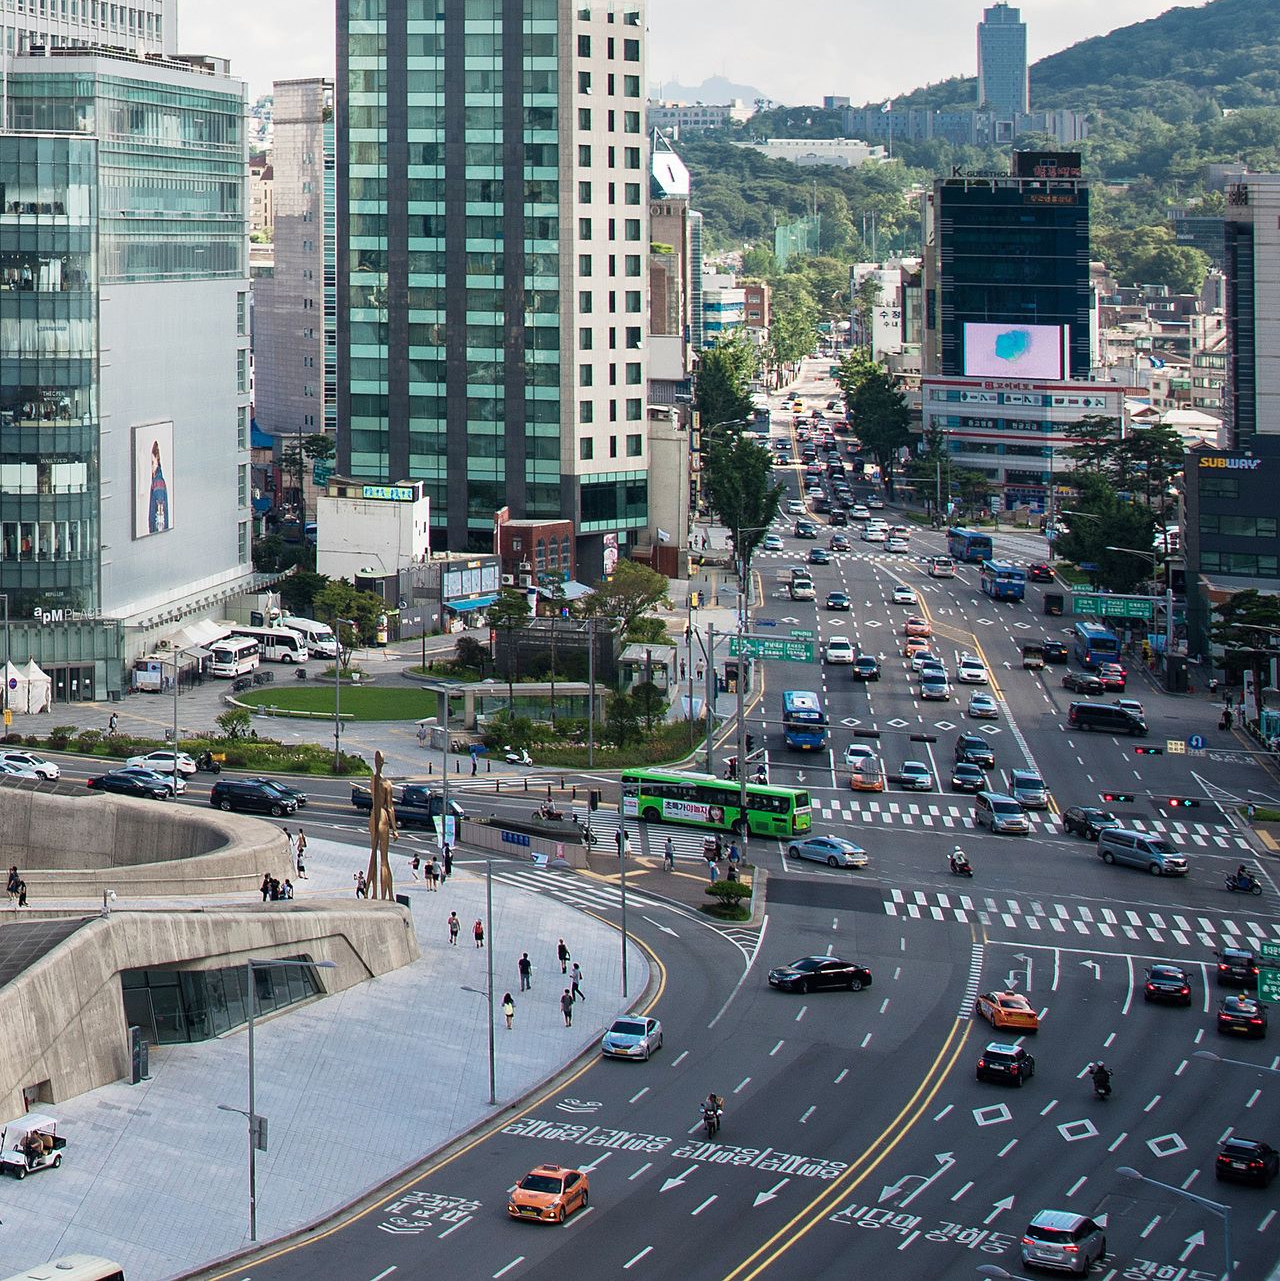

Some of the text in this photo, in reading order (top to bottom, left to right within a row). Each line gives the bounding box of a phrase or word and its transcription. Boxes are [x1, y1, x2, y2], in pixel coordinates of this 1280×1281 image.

[1199, 457, 1261, 469] SUBWAY
[33, 606, 63, 625] apM
[384, 1201, 470, 1222] 자전거
[829, 1203, 923, 1235] 신당역
[924, 1220, 1017, 1254] 광희동
